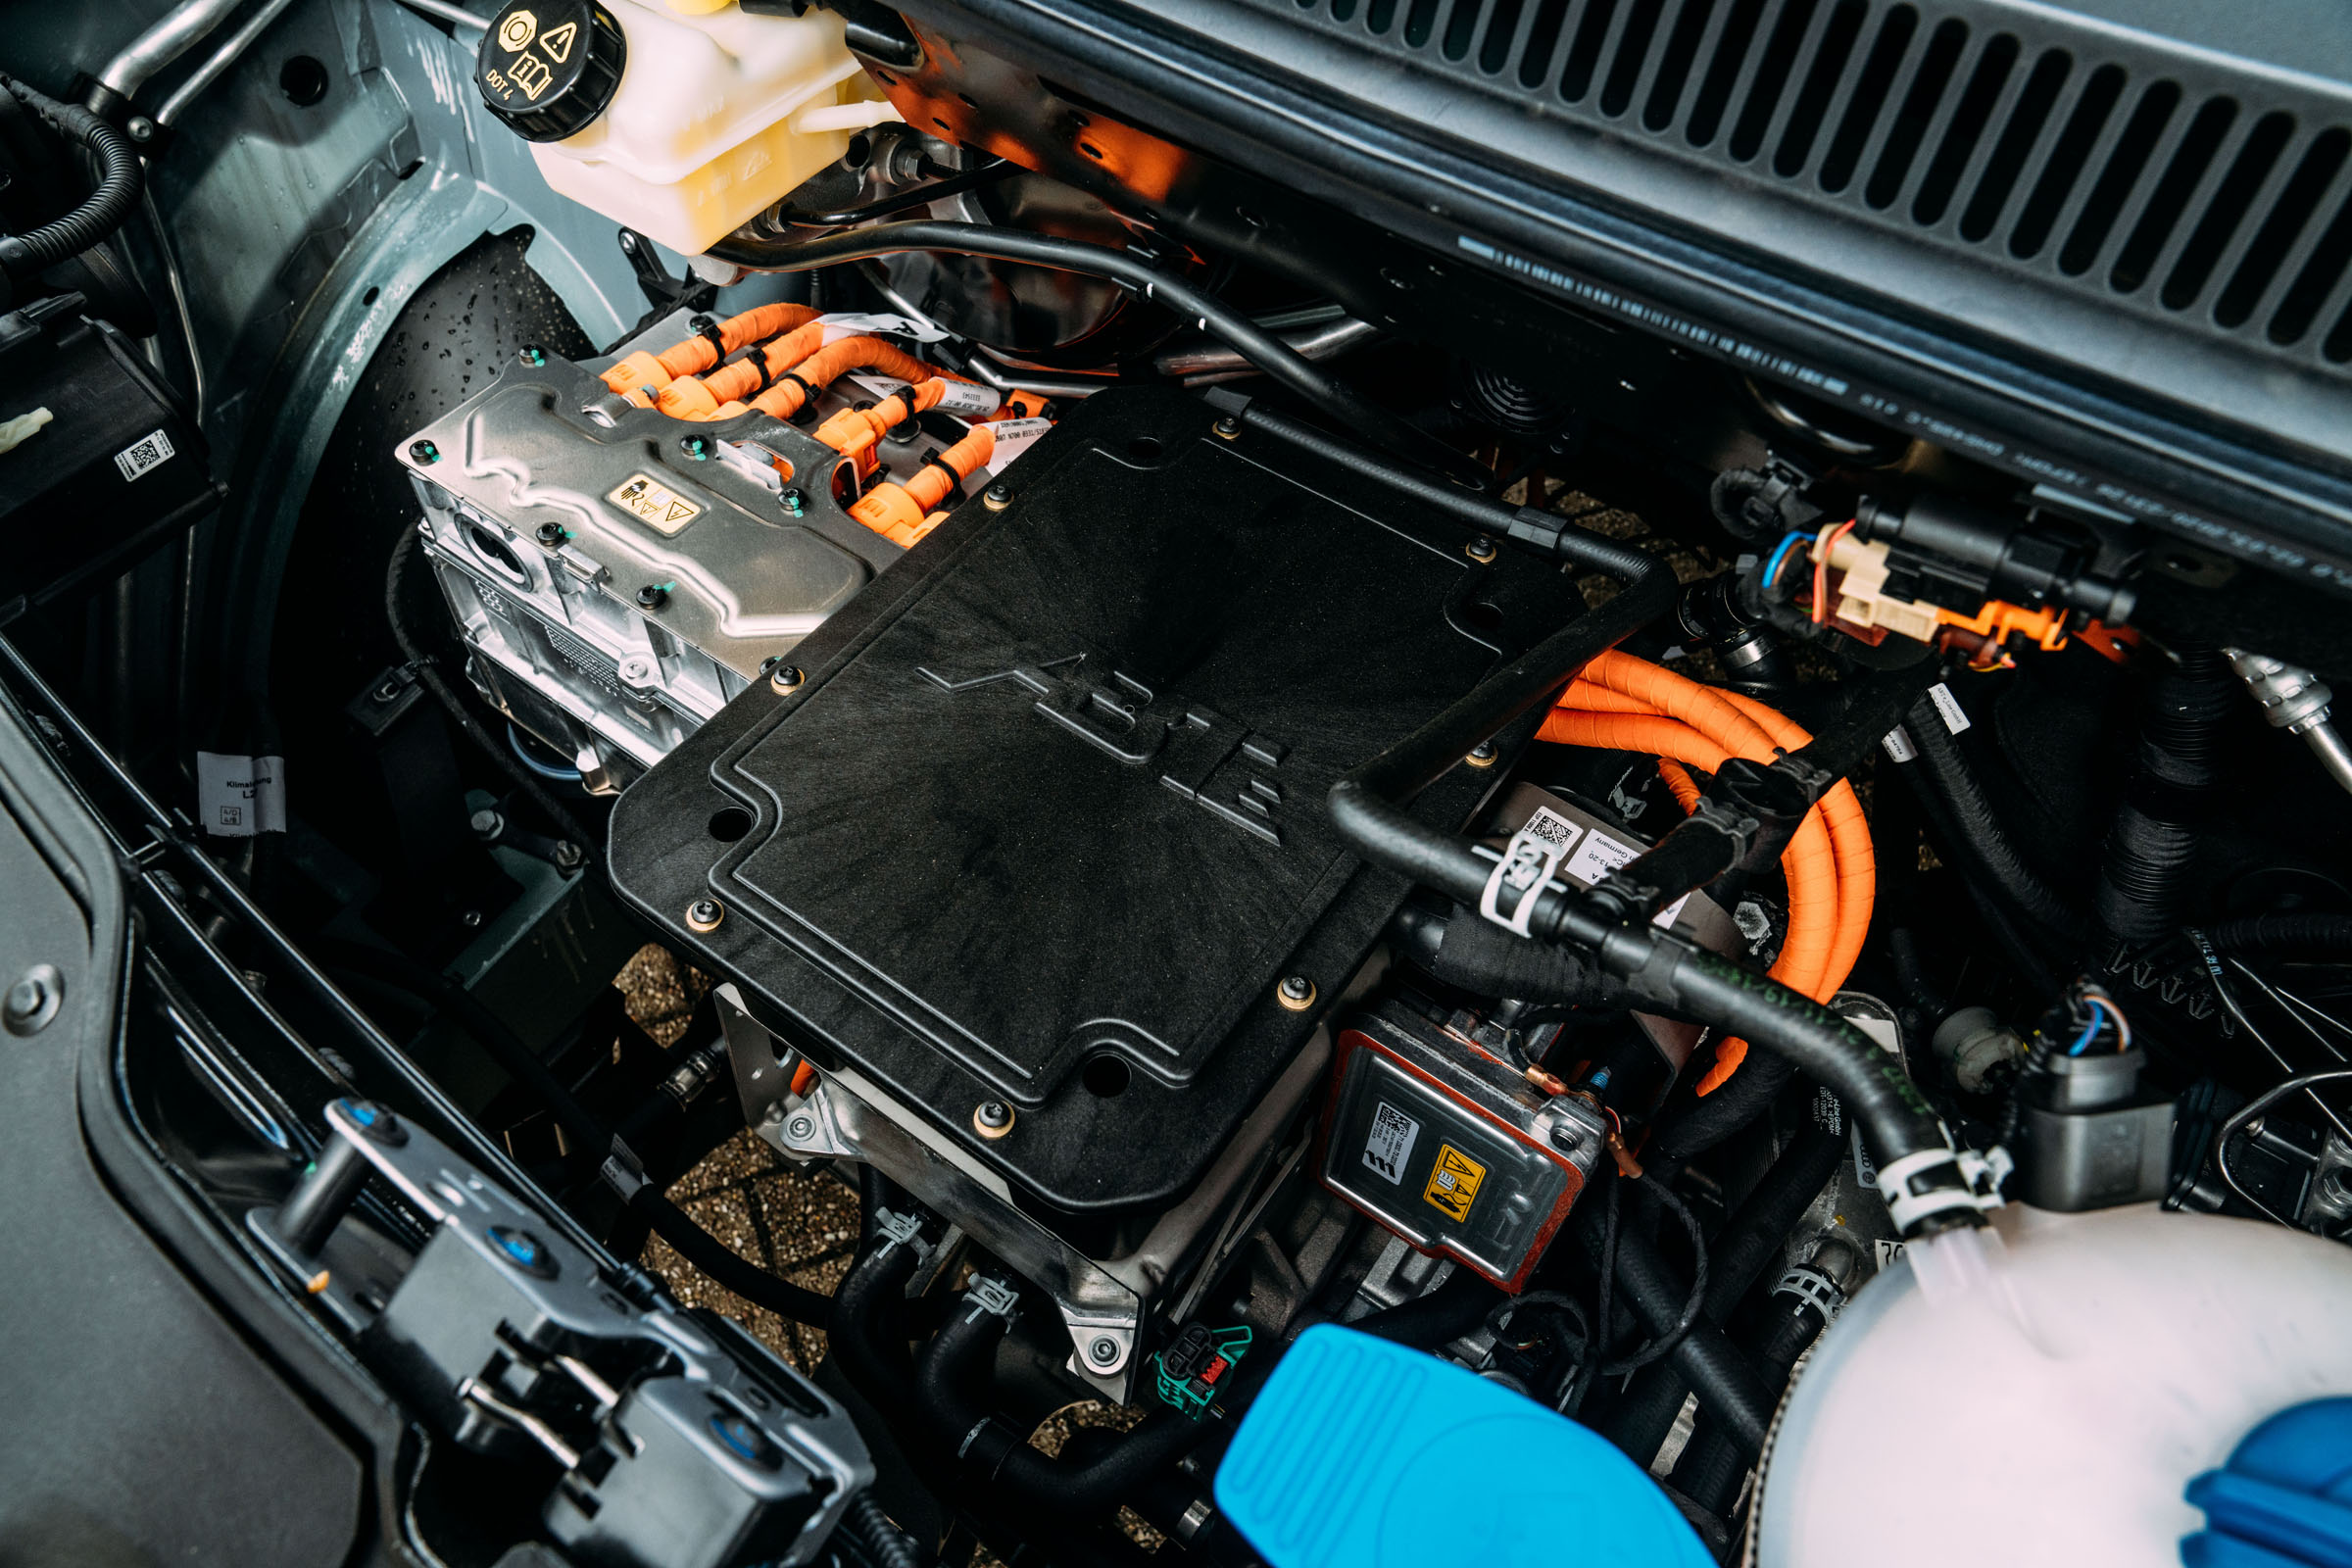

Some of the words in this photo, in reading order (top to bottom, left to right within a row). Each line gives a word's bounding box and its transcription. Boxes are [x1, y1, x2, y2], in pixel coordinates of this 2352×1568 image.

[485, 69, 509, 93] DOT
[503, 88, 514, 101] 4
[1594, 837, 1628, 858] Germany
